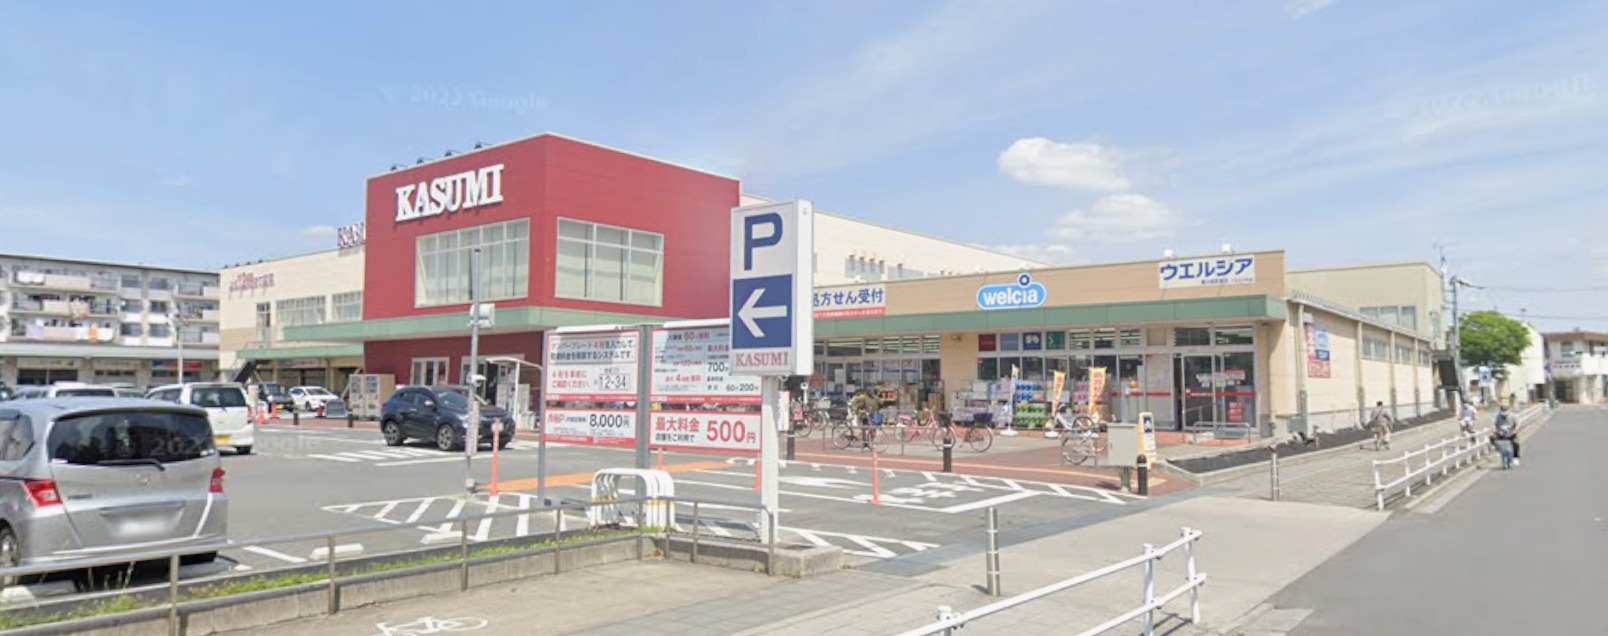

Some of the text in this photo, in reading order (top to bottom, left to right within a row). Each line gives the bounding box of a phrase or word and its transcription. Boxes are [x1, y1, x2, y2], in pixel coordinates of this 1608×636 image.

[395, 164, 504, 222] KASUMI
[743, 212, 784, 271] P
[1160, 258, 1253, 281] ウエルシア
[982, 284, 1039, 306] welcia
[735, 352, 789, 367] KASUMI
[599, 375, 627, 389] 12-34
[655, 416, 701, 433] 最大料金
